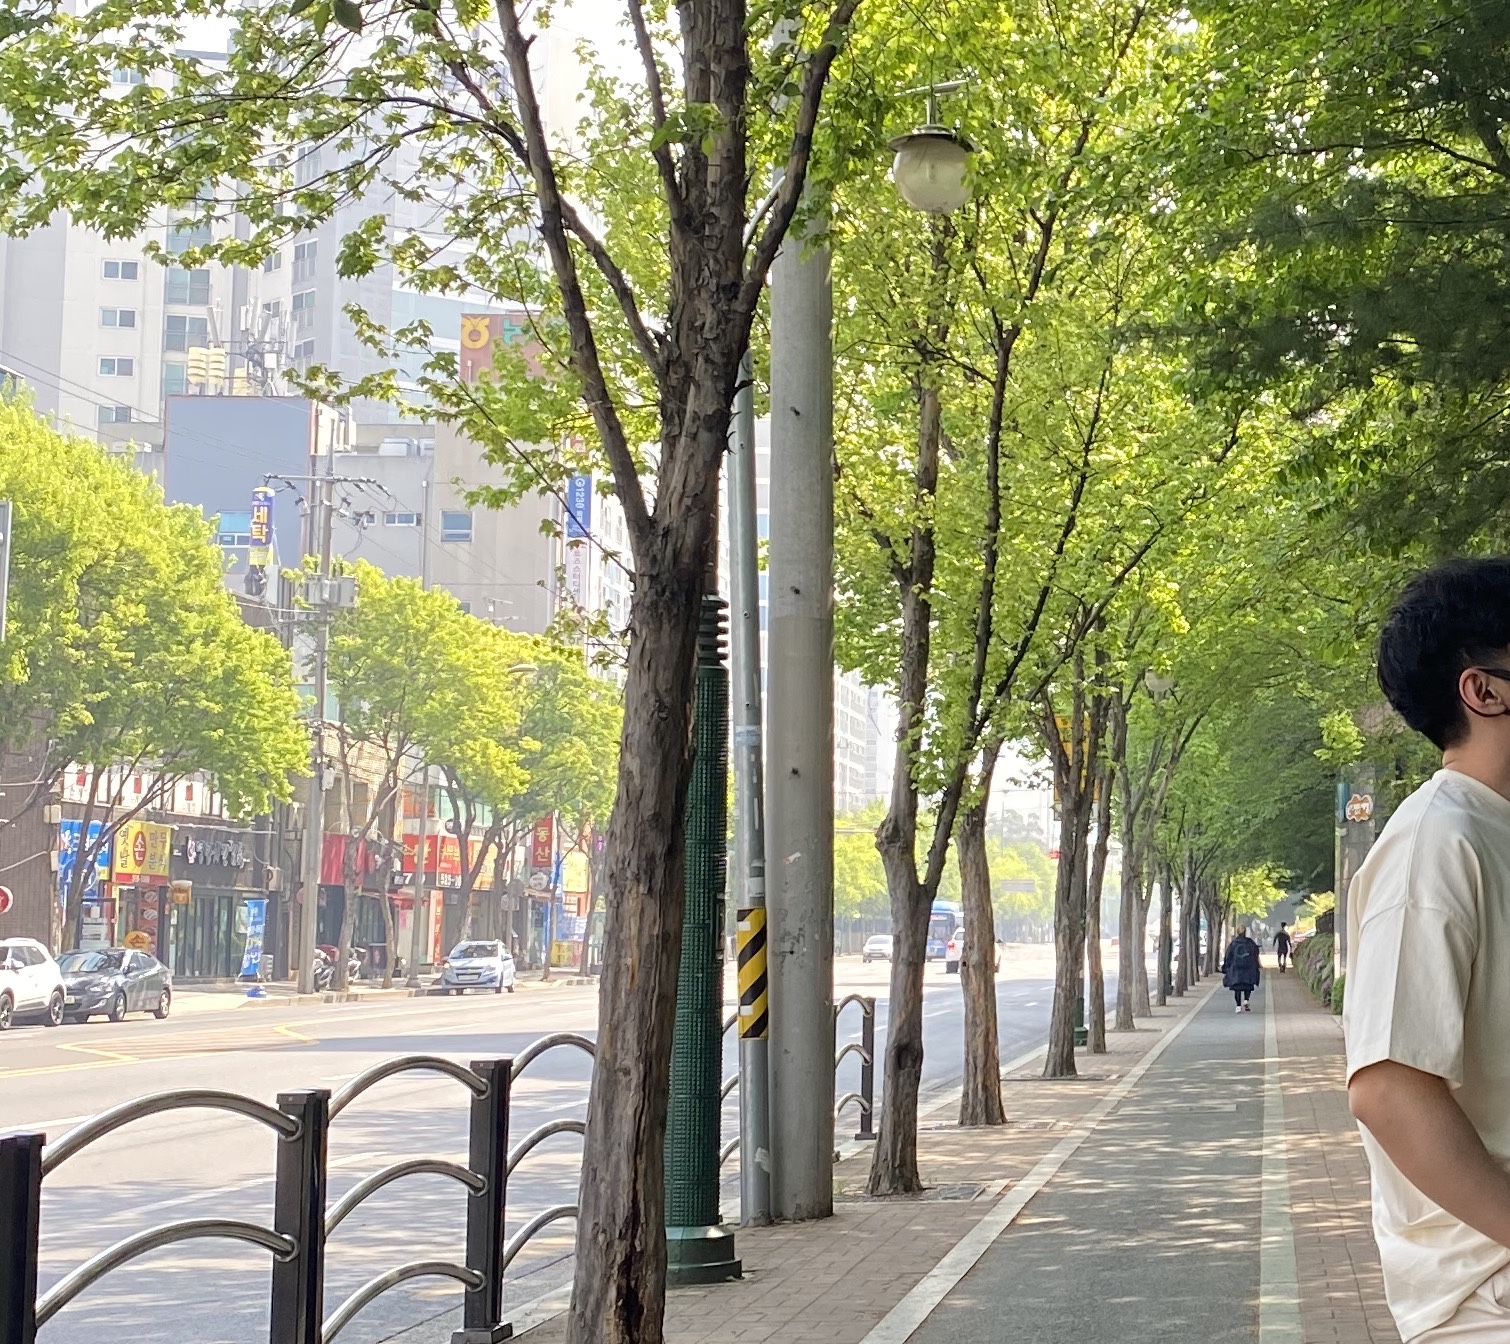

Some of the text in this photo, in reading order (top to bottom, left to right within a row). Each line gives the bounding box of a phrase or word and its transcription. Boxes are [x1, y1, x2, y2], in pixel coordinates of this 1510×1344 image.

[252, 506, 269, 543] 세탁
[120, 827, 130, 868] 옛날
[134, 833, 146, 860] 손
[535, 827, 550, 862] 동산
